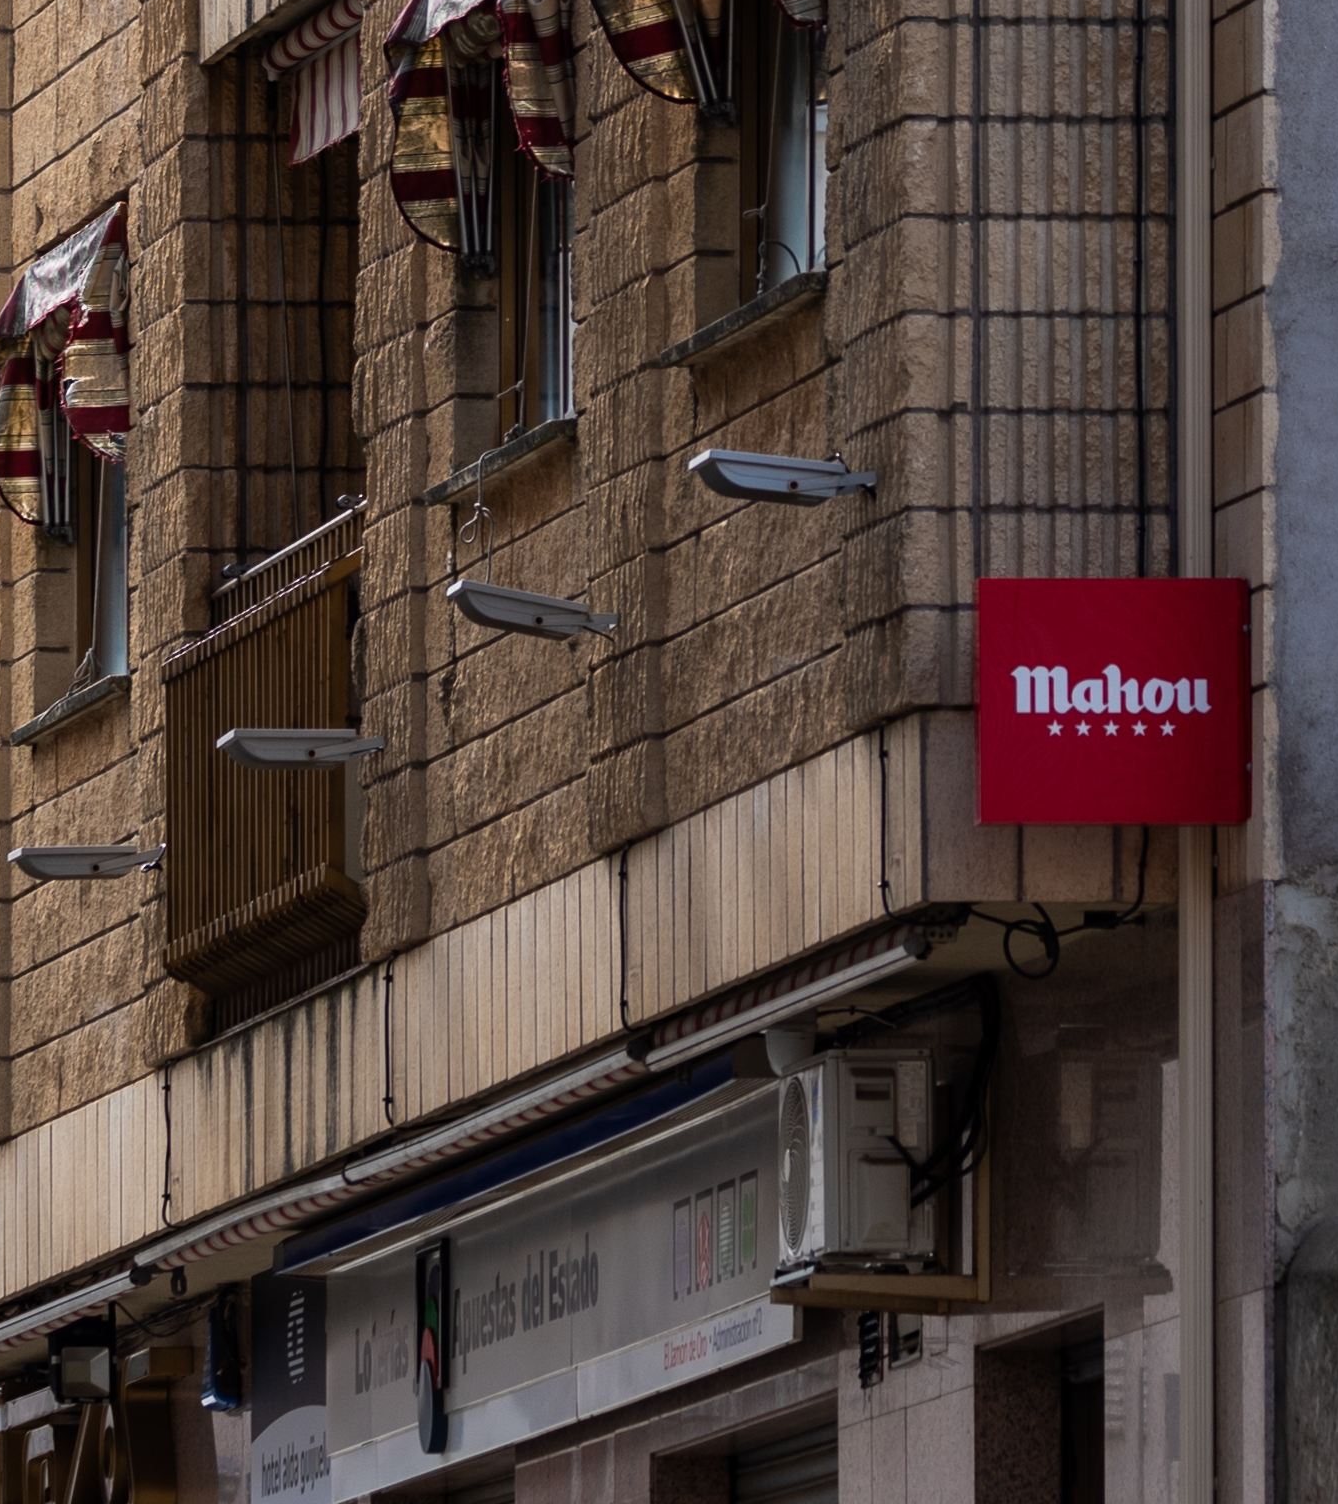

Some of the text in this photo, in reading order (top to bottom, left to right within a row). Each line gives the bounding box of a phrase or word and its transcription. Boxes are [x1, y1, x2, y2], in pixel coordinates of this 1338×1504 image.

[1011, 663, 1212, 714] Mahou
[451, 1271, 516, 1375] Apuestas
[522, 1249, 545, 1332] del
[549, 1232, 599, 1322] Estado
